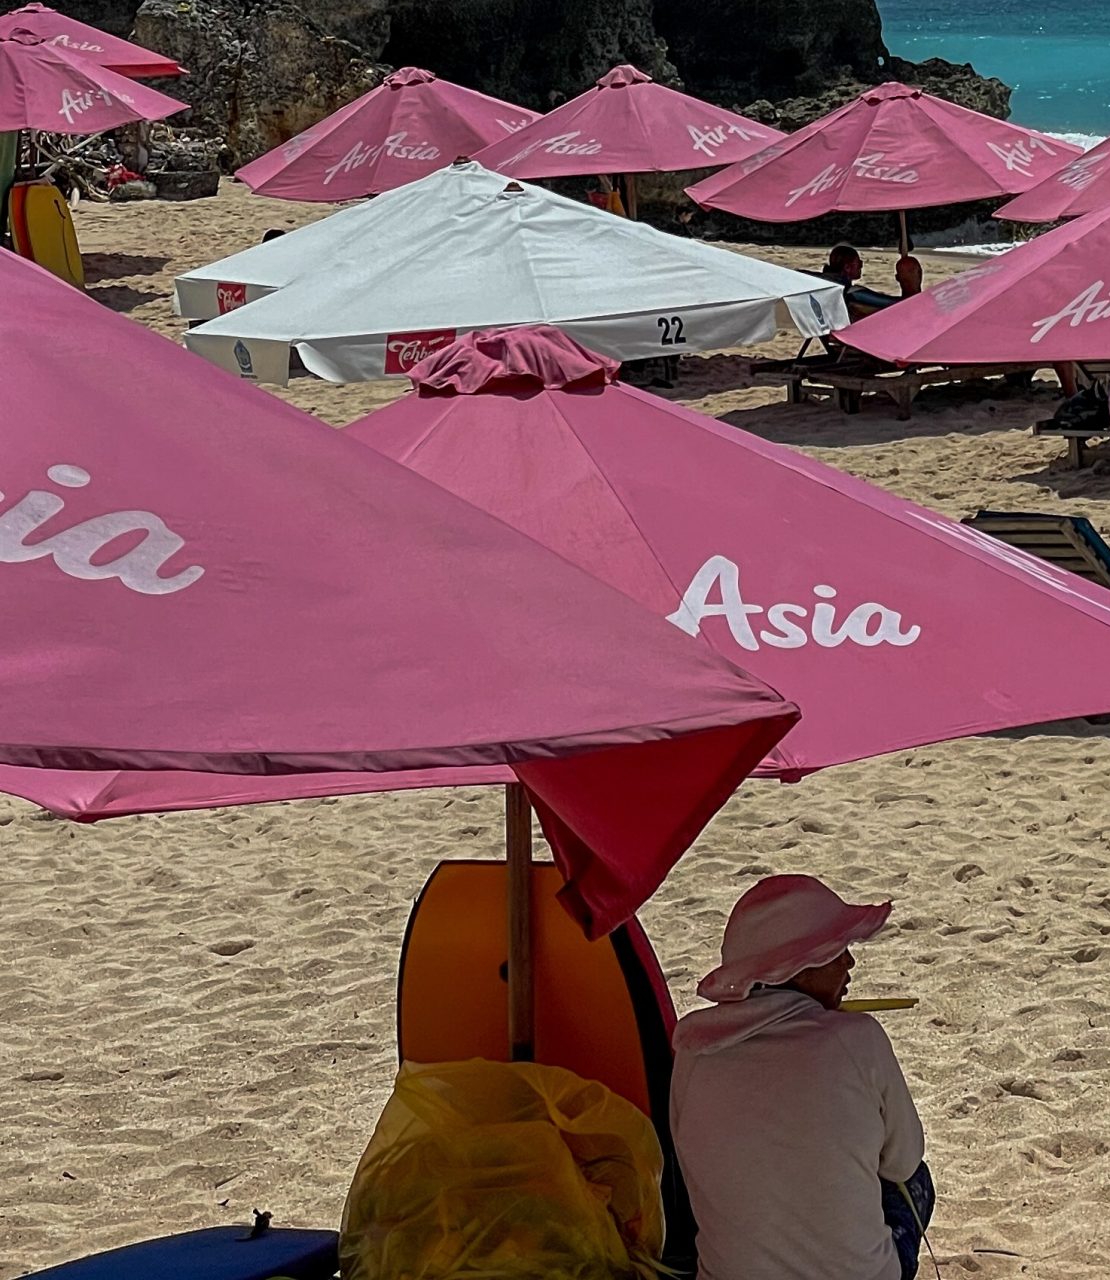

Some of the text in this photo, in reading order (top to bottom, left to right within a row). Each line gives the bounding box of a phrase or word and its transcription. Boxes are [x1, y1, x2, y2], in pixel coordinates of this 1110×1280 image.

[658, 316, 687, 345] 22
[0, 463, 206, 595] ia
[665, 555, 921, 651] Asia
